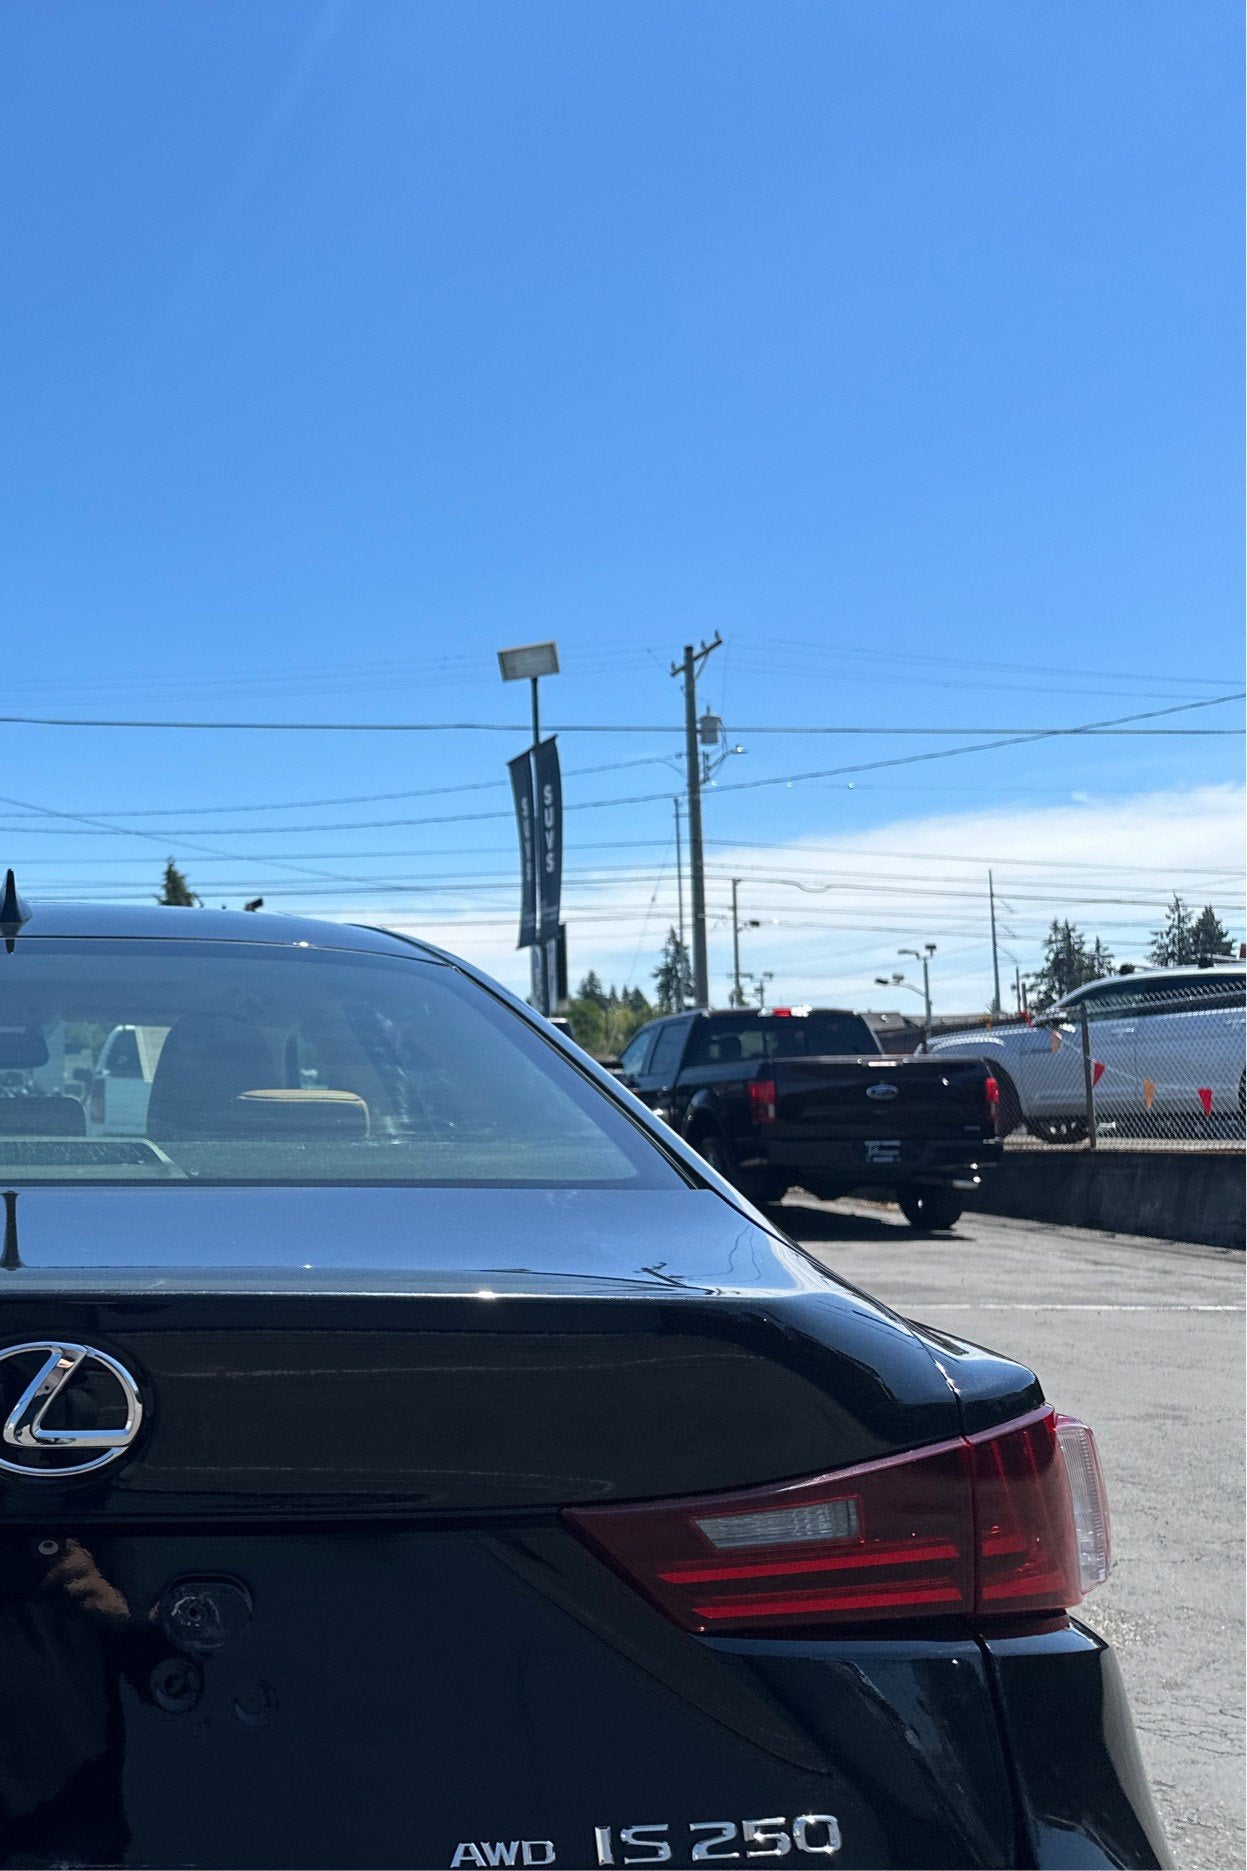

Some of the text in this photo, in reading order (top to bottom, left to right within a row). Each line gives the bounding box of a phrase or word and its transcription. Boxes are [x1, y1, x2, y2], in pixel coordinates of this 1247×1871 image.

[543, 784, 555, 873] SUVS
[450, 1814, 842, 1868] AWD IS 250
